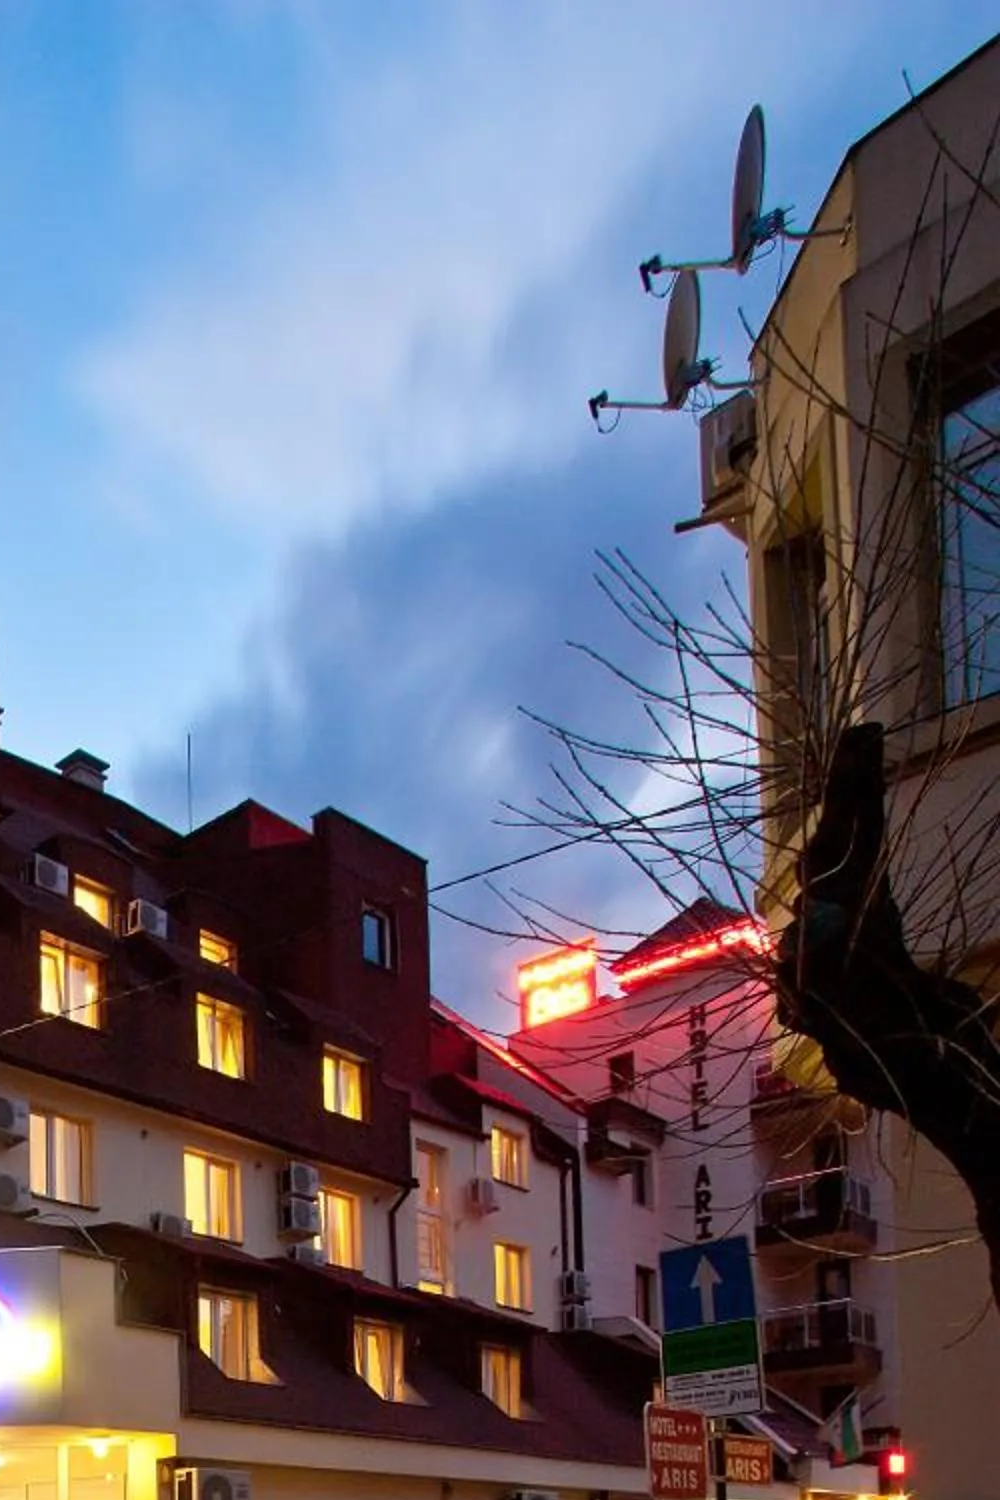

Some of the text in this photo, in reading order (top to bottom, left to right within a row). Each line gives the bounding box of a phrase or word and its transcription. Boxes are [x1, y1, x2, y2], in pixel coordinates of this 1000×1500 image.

[689, 1005, 713, 1240] HOTEL ARI
[661, 1467, 698, 1489] ARIS
[726, 1457, 761, 1480] ARIS
